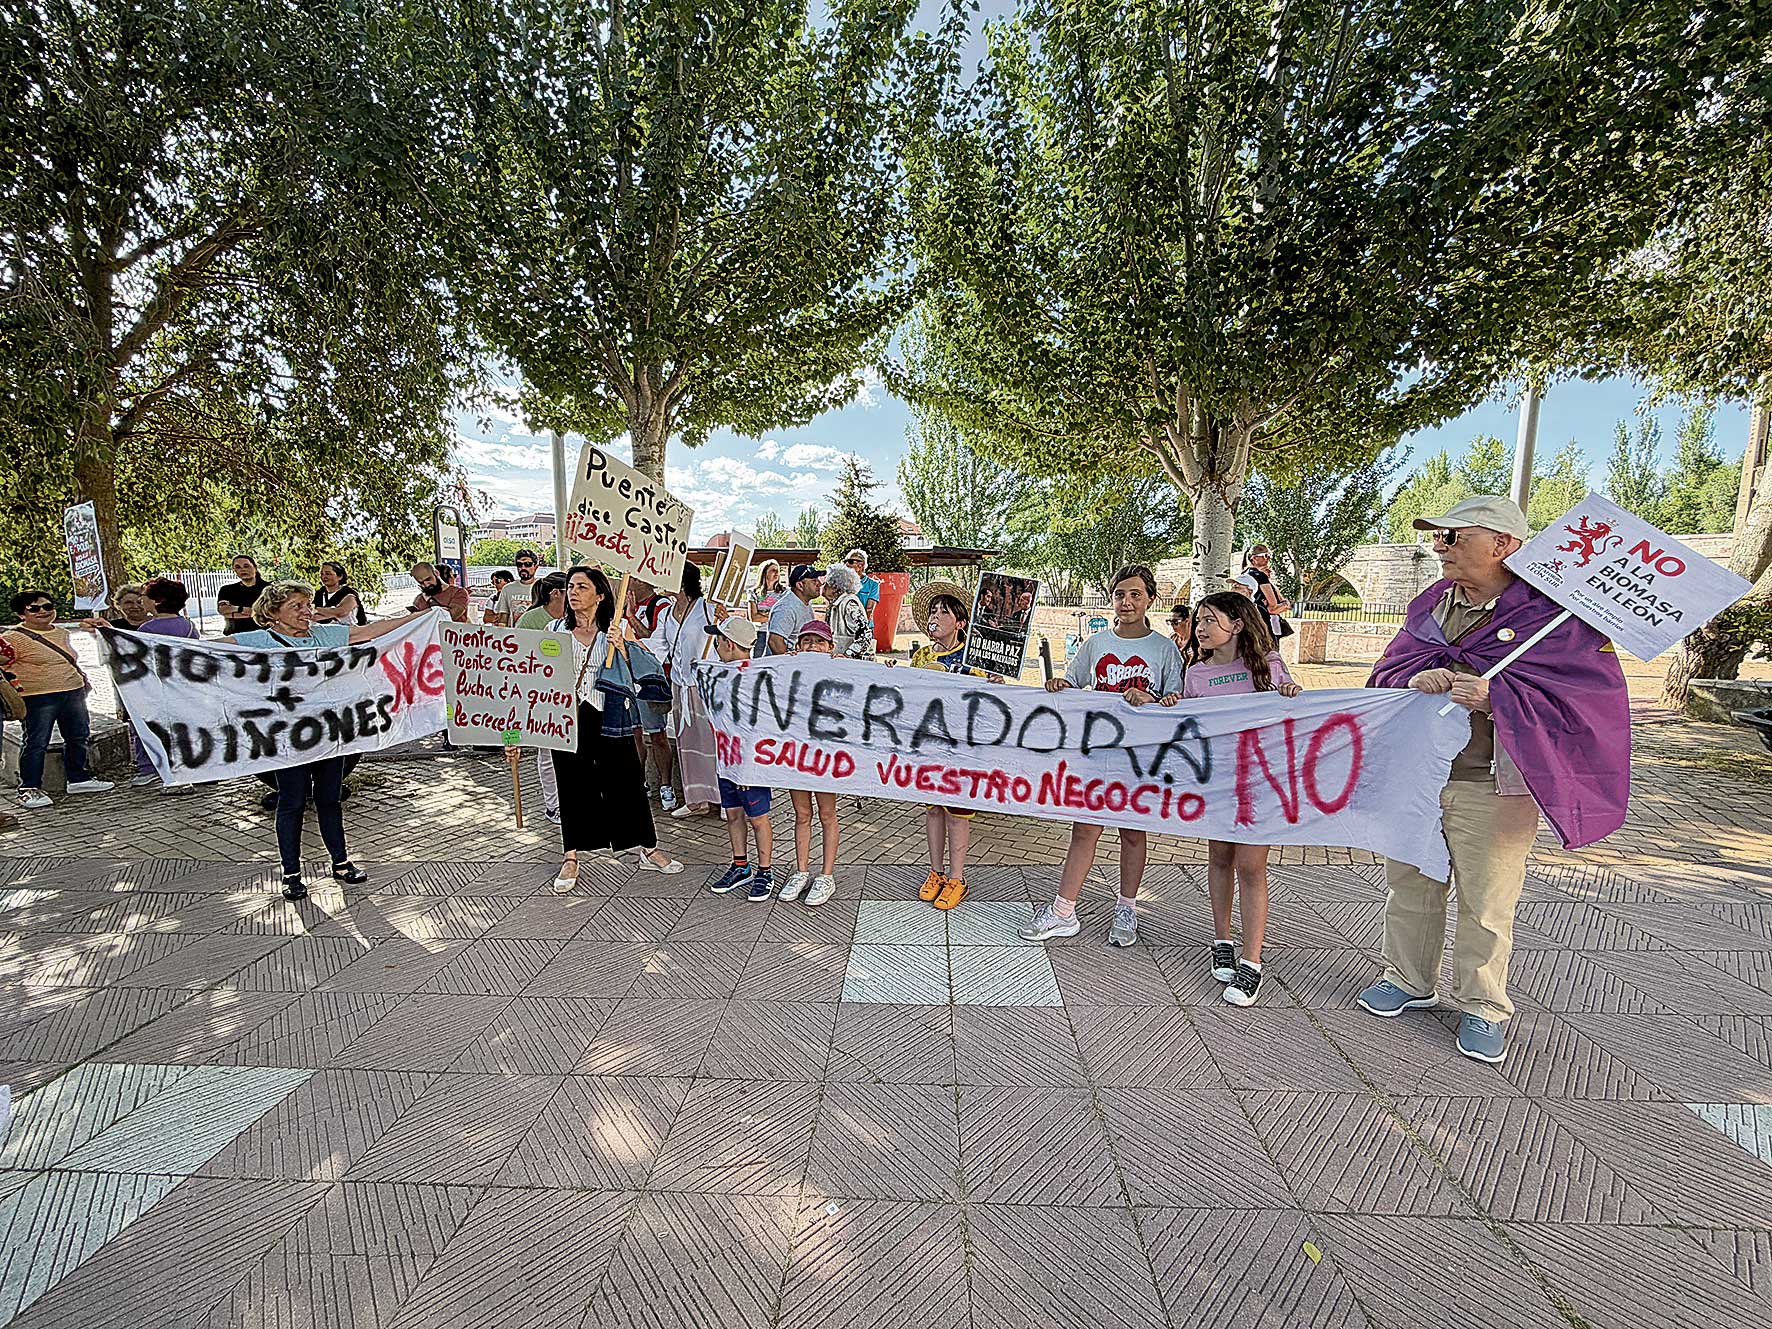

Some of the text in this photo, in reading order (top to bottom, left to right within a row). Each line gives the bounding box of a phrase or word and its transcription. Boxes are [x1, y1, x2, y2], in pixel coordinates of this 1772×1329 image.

[586, 447, 668, 516] Puente
[578, 497, 687, 554] dice Castro
[1613, 557, 1656, 586] A LA
[1628, 539, 1687, 577] NO
[1585, 575, 1664, 627] EN LEÓN
[1599, 566, 1685, 623] BIOMASA
[968, 647, 1018, 666] PARA LOS MALVADOS
[970, 636, 981, 649] NO
[1005, 645, 1021, 658] PAZ
[1208, 672, 1249, 687] FOREVER
[527, 688, 573, 710] quien
[526, 709, 574, 744] hucha?
[691, 662, 1365, 827] NCINERADORA NO
[754, 738, 856, 779] SALUD
[876, 753, 1031, 804] VUESTRO
